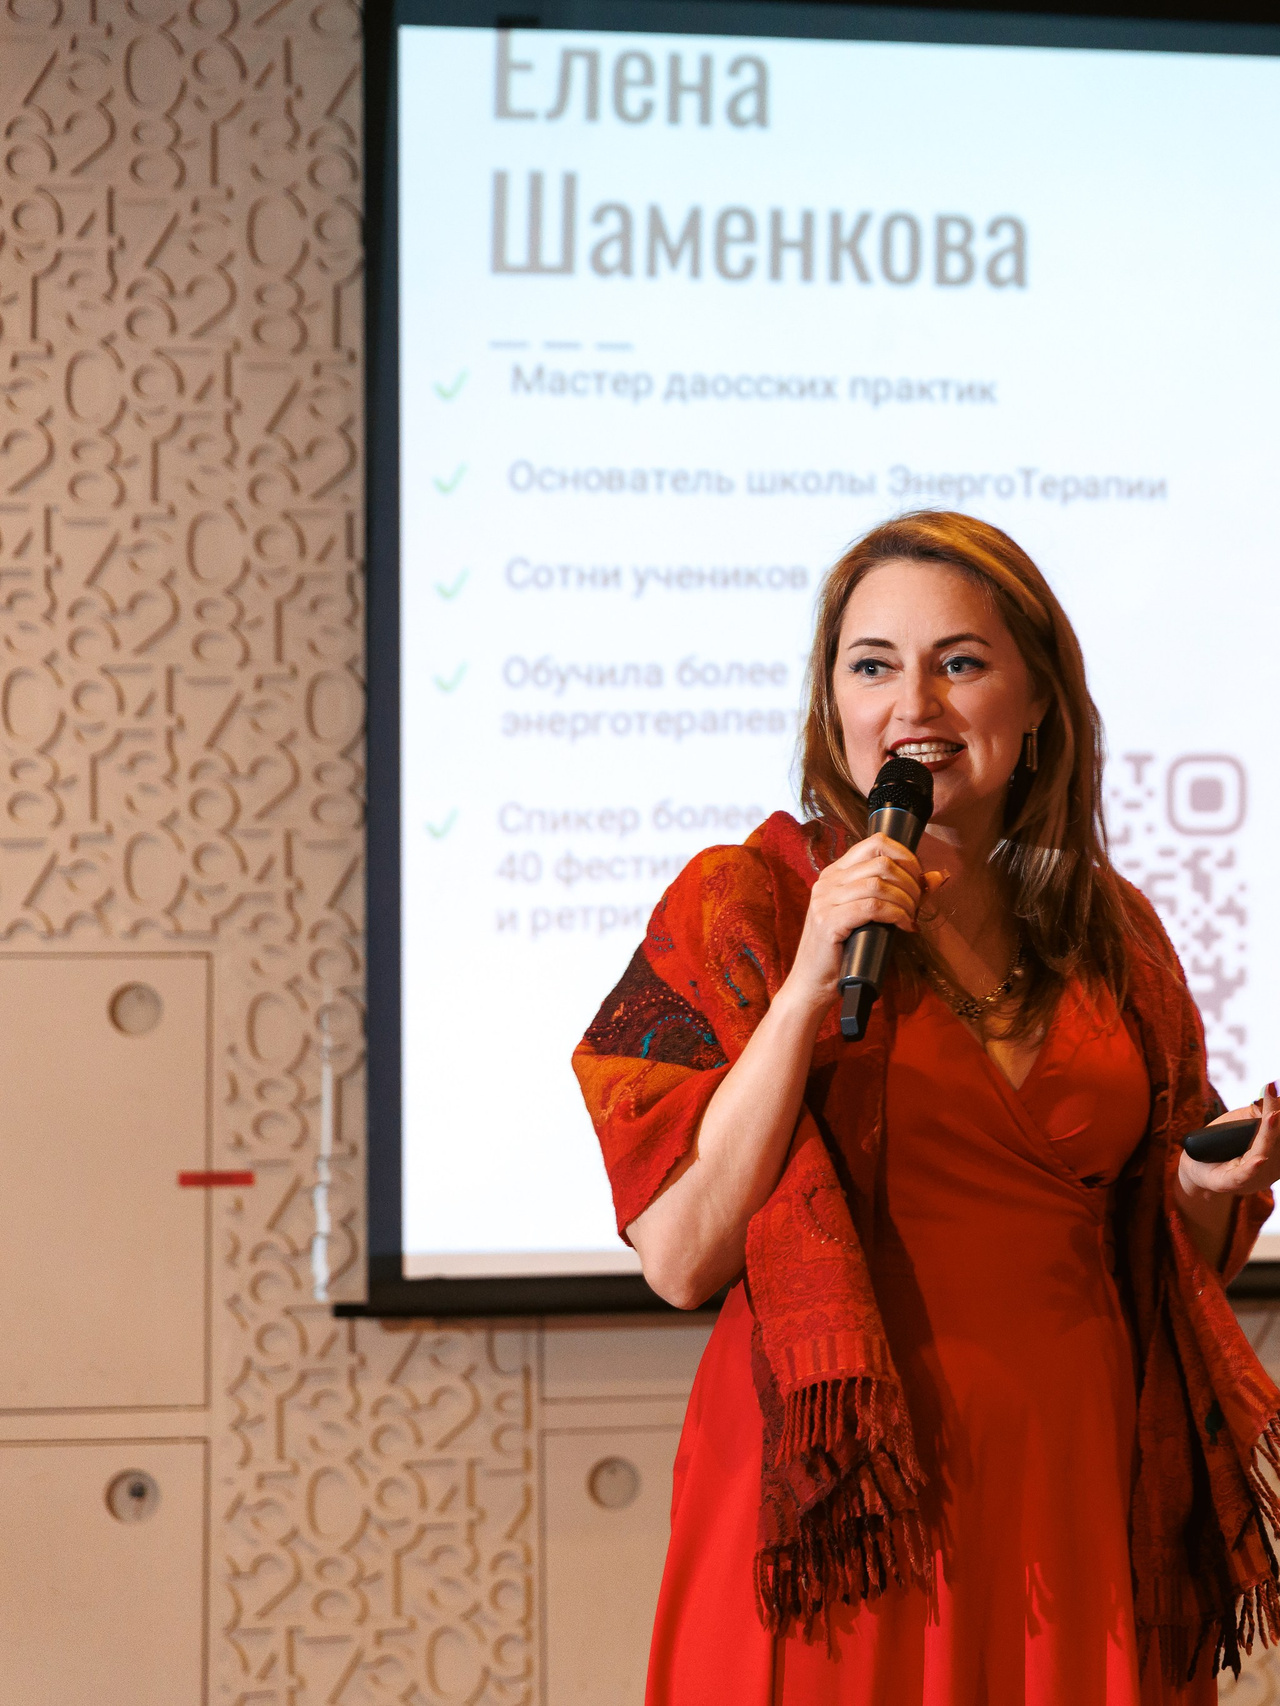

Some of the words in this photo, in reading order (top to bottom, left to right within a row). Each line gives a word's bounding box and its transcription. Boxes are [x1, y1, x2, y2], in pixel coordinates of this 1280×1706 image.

[492, 17, 771, 130] Елена
[490, 168, 1029, 291] Шаменкова
[510, 363, 655, 404] Мастер
[663, 370, 838, 404] даосских
[848, 376, 998, 408] практик
[507, 460, 736, 496] Основатель
[746, 467, 877, 497] школы
[888, 464, 1168, 504] ЭнергоТерапии
[503, 555, 624, 591] Сотни
[632, 564, 809, 600] учеников
[501, 655, 665, 697] Обучила
[675, 652, 790, 689] более
[497, 801, 643, 841] Спикер
[651, 797, 766, 832] более
[495, 850, 544, 885] 40
[494, 907, 520, 934] и
[529, 902, 654, 939] ретри
